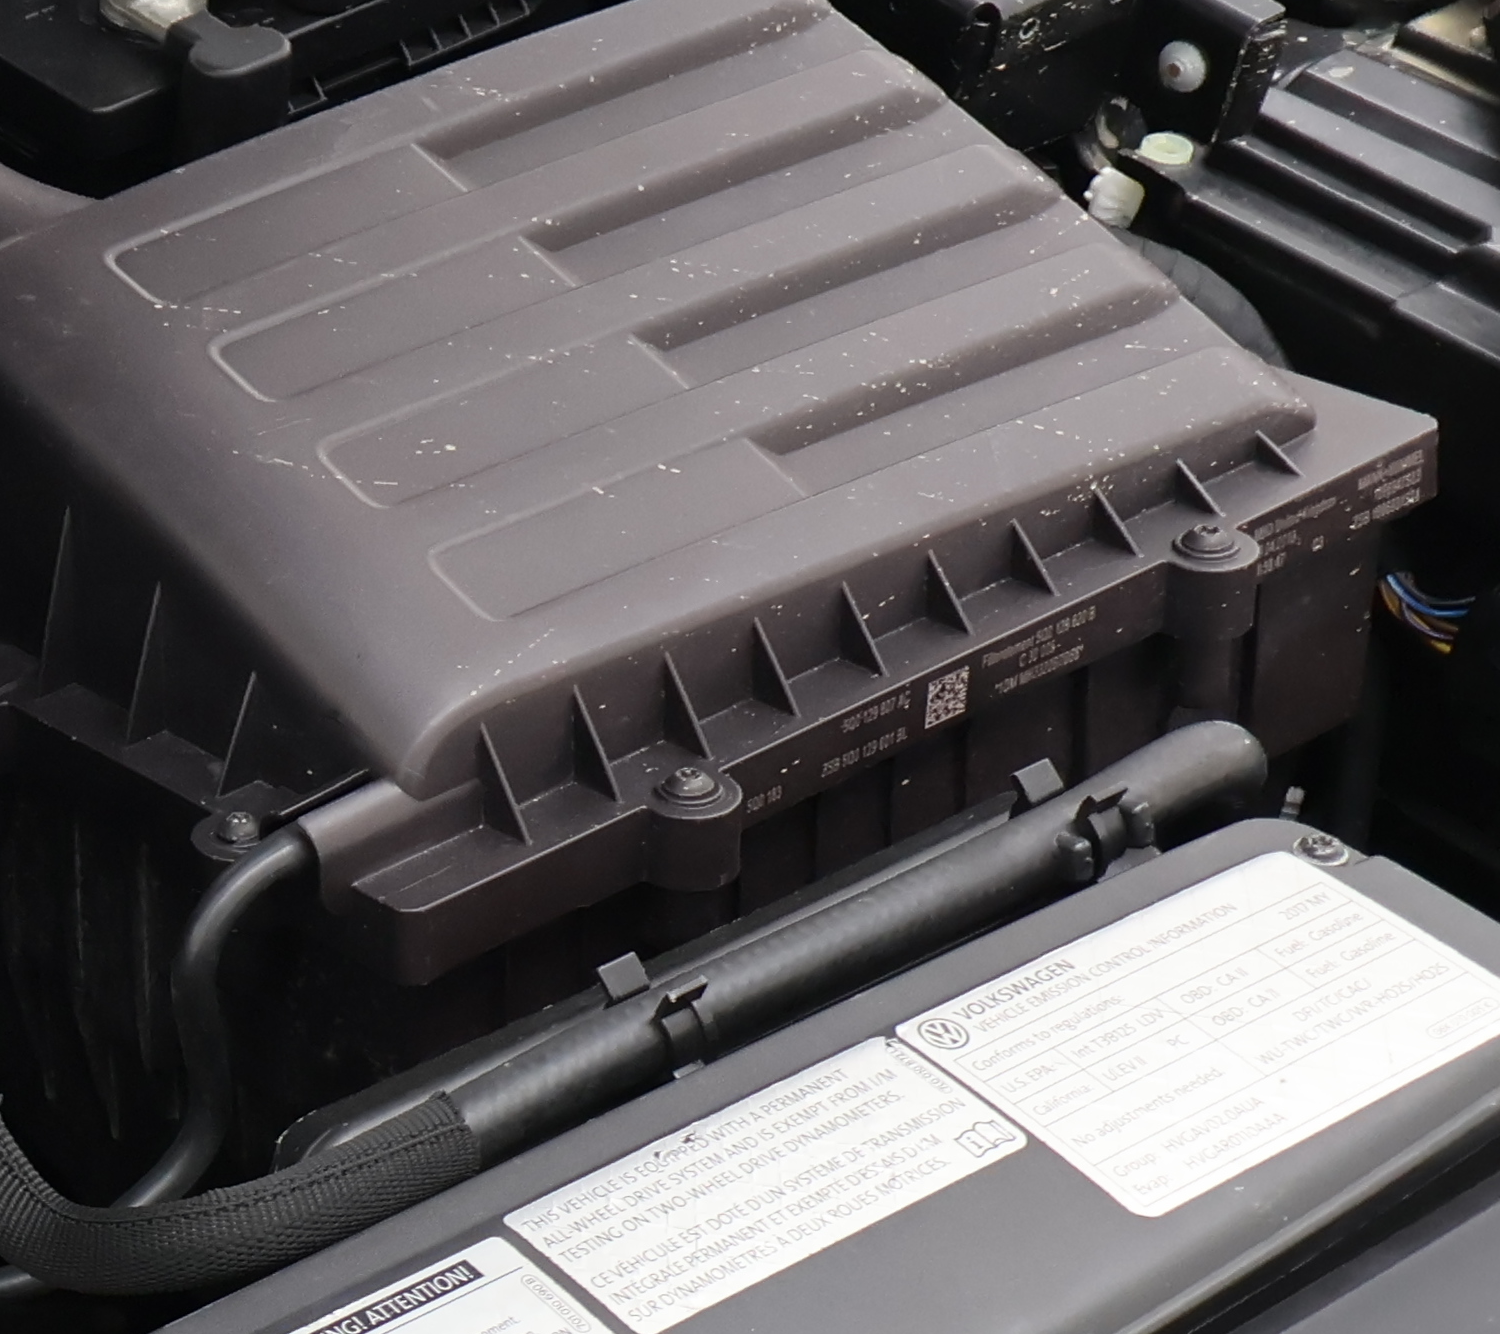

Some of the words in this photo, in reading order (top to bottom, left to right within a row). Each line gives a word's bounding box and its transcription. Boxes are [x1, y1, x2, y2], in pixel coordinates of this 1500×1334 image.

[951, 958, 1076, 1020] VOLKSWAGEN
[971, 1001, 1031, 1033] VEHICLE
[1024, 972, 1092, 1008] EMISSION
[1087, 944, 1153, 977] CONTROL
[1145, 902, 1238, 949] INFORMATION
[519, 1206, 561, 1232] THIS
[555, 1178, 623, 1214] VEHICLE
[616, 1170, 638, 1185] IS
[704, 1115, 751, 1142] WITH
[747, 1110, 765, 1123] A
[758, 1067, 848, 1116] PERMANENT
[541, 1203, 627, 1249] ALL-WHEEL
[619, 1177, 672, 1208] DRIVE
[666, 1151, 726, 1186] SYSTEM
[722, 1135, 759, 1159] AND
[755, 1127, 775, 1142] IS
[770, 1099, 829, 1134] EXEMPT
[826, 1079, 872, 1107] FROM
[866, 1068, 898, 1086] I/M
[556, 1225, 625, 1263] TESTING
[620, 1212, 652, 1232] ON
[643, 1169, 743, 1219] TWO-WHEEL
[737, 1145, 787, 1175] DRIVE
[781, 1089, 905, 1153] DYNAMOMETERS.
[364, 1264, 474, 1326] ATTENTION!
